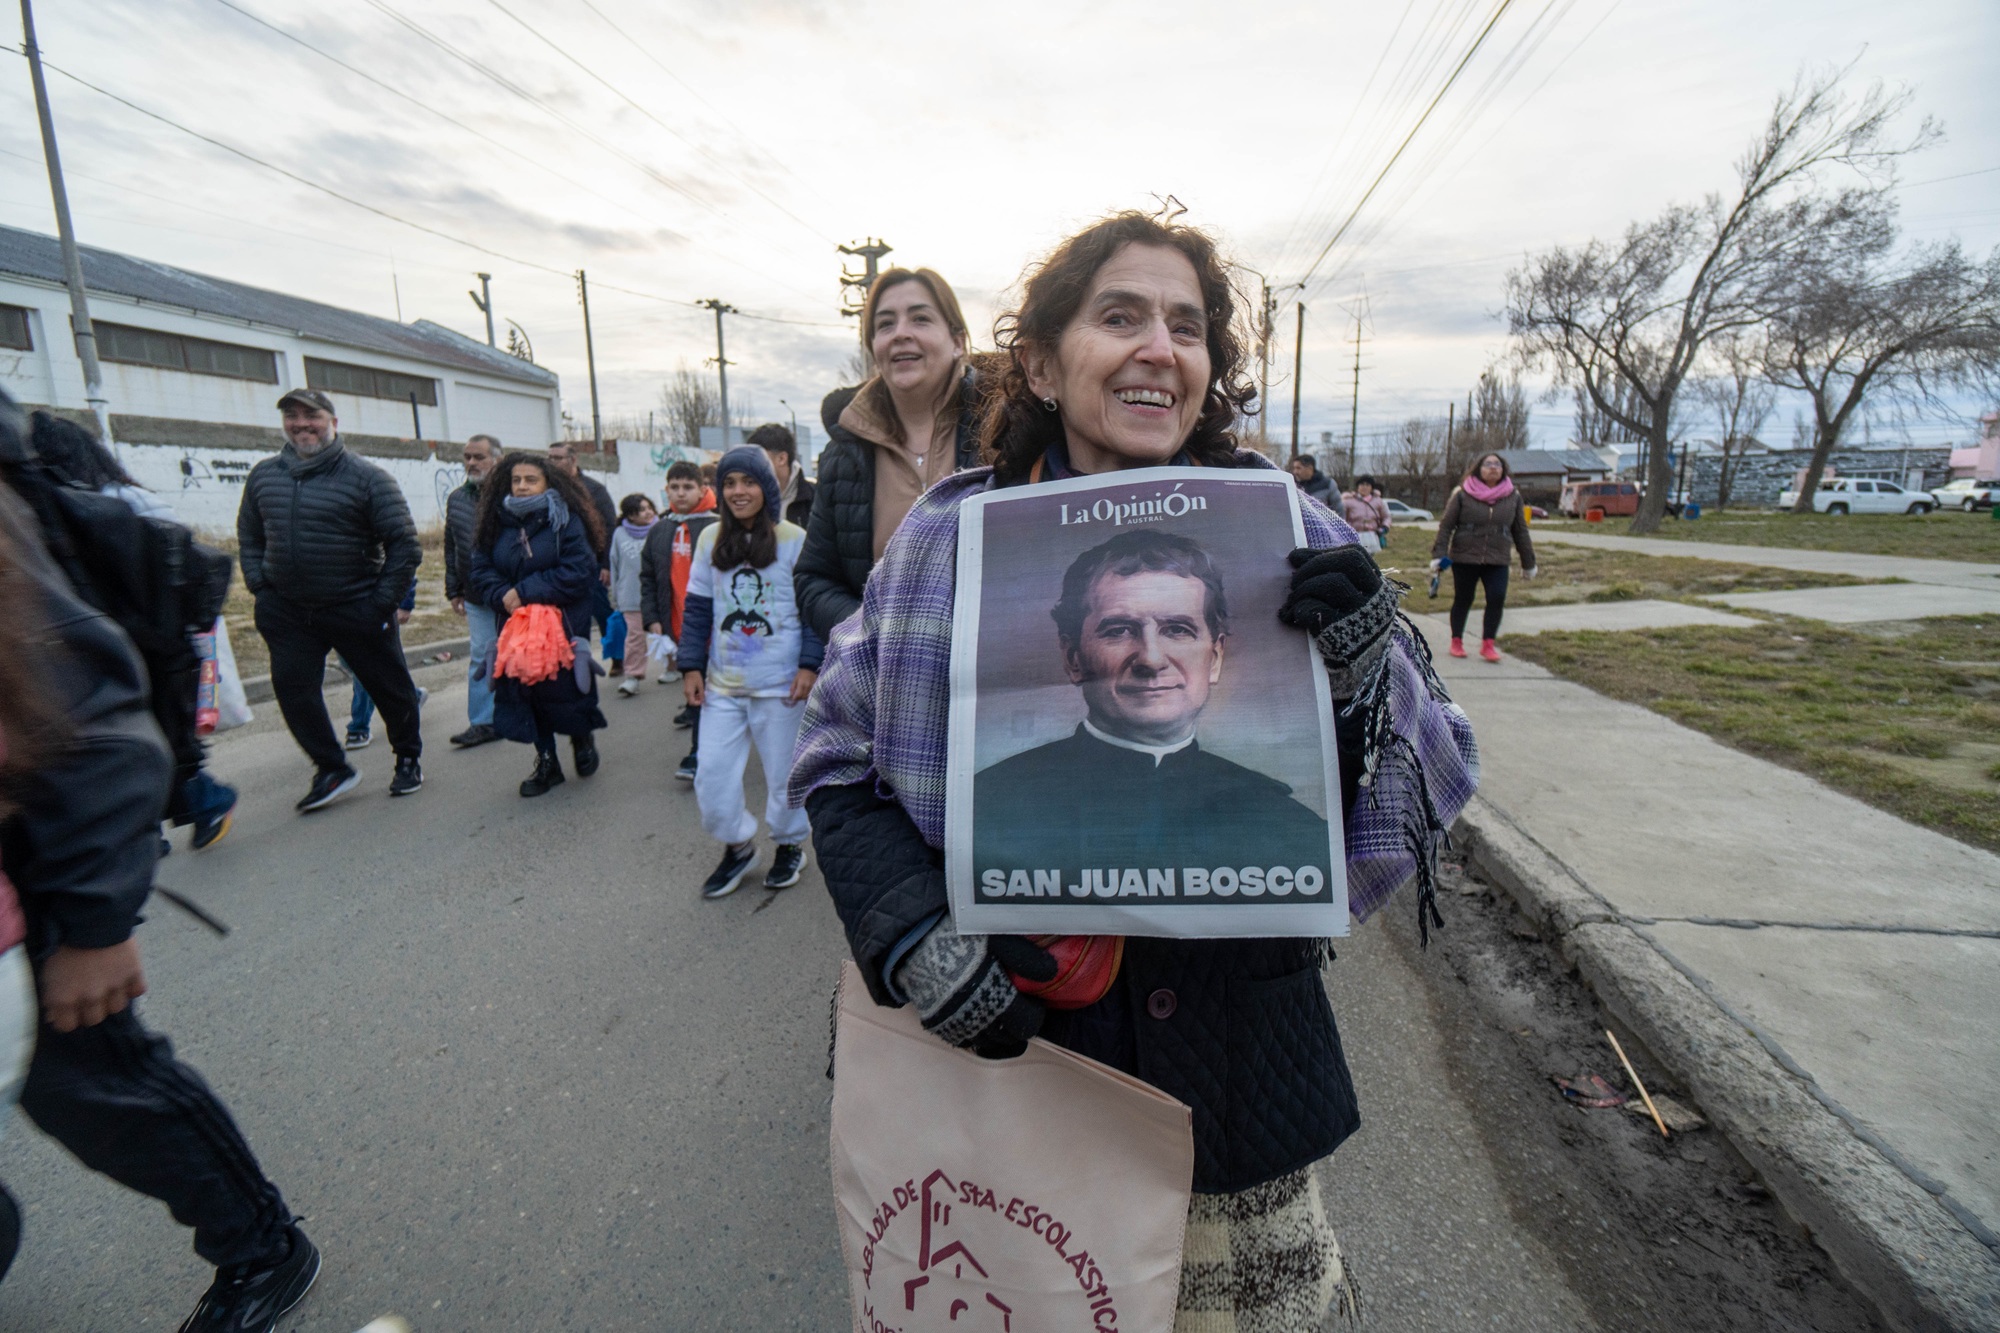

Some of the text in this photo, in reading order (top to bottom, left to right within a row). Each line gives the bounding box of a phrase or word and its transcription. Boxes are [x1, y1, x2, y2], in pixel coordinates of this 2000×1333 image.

[1060, 503, 1090, 526] La
[1126, 515, 1164, 526] AUSTRAL
[980, 865, 1325, 898] SAN JUAN BOSCO
[893, 1178, 920, 1211] DE
